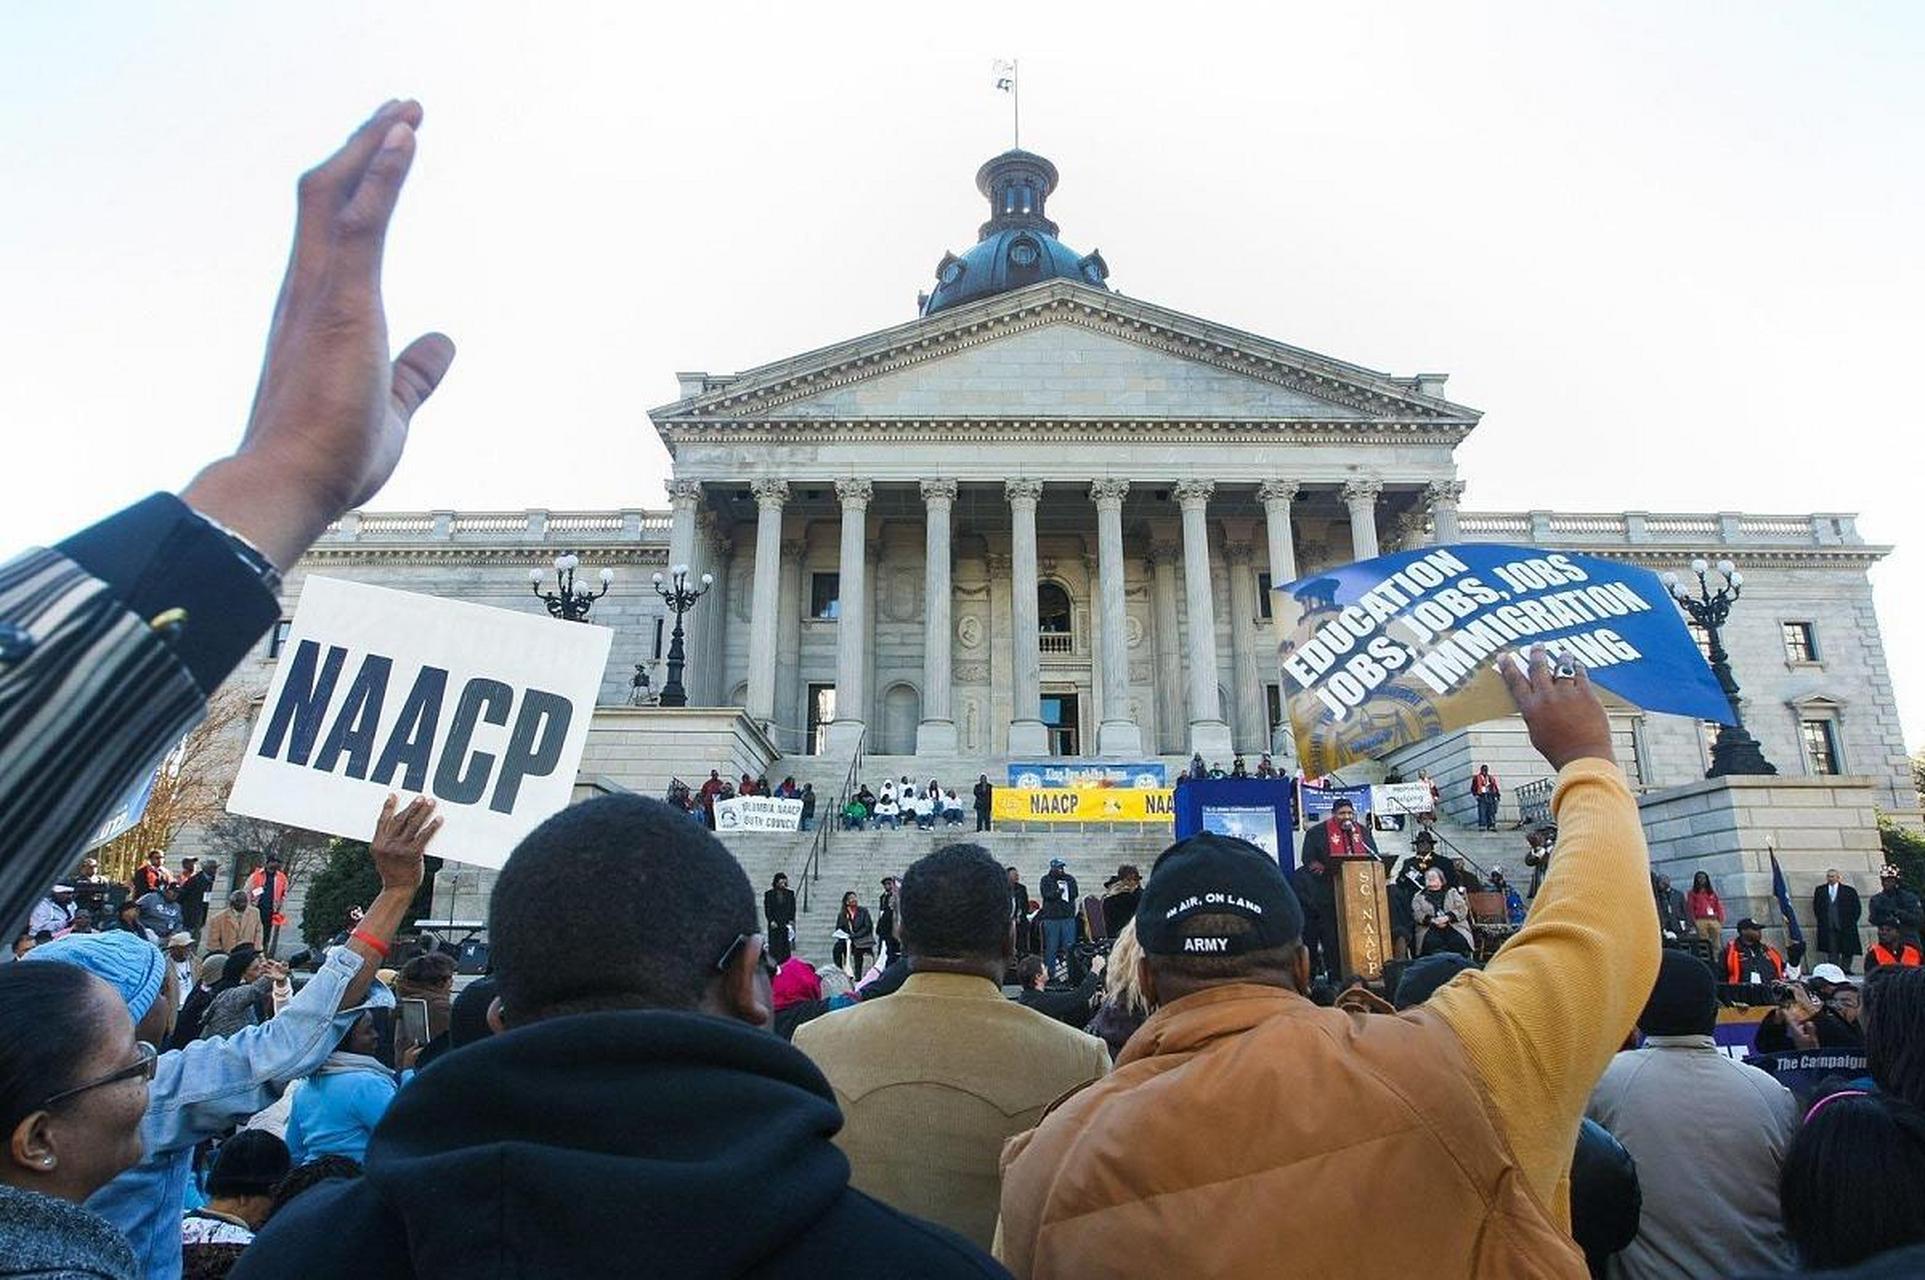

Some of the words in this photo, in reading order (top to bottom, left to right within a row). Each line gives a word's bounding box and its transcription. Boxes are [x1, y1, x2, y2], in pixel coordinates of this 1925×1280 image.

[1283, 550, 1469, 688] EDUCATION
[1315, 636, 1417, 721] JOBS,
[1401, 577, 1511, 644] JOBS,
[1492, 554, 1589, 594] JOBS
[1410, 582, 1651, 694] IMMIGRATION
[1492, 629, 1642, 682] TING
[258, 639, 573, 815] NAACP
[1030, 794, 1078, 814] NAACP
[1145, 795, 1174, 814] NAA
[1179, 897, 1202, 912] AIR,
[1205, 893, 1224, 903] ON
[1228, 894, 1262, 915] LAND
[1360, 872, 1371, 896] SC
[1184, 938, 1228, 951] ARMY
[1363, 908, 1378, 975] NAACP
[1777, 1057, 1799, 1071] The
[1800, 1055, 1867, 1070] Campaign
